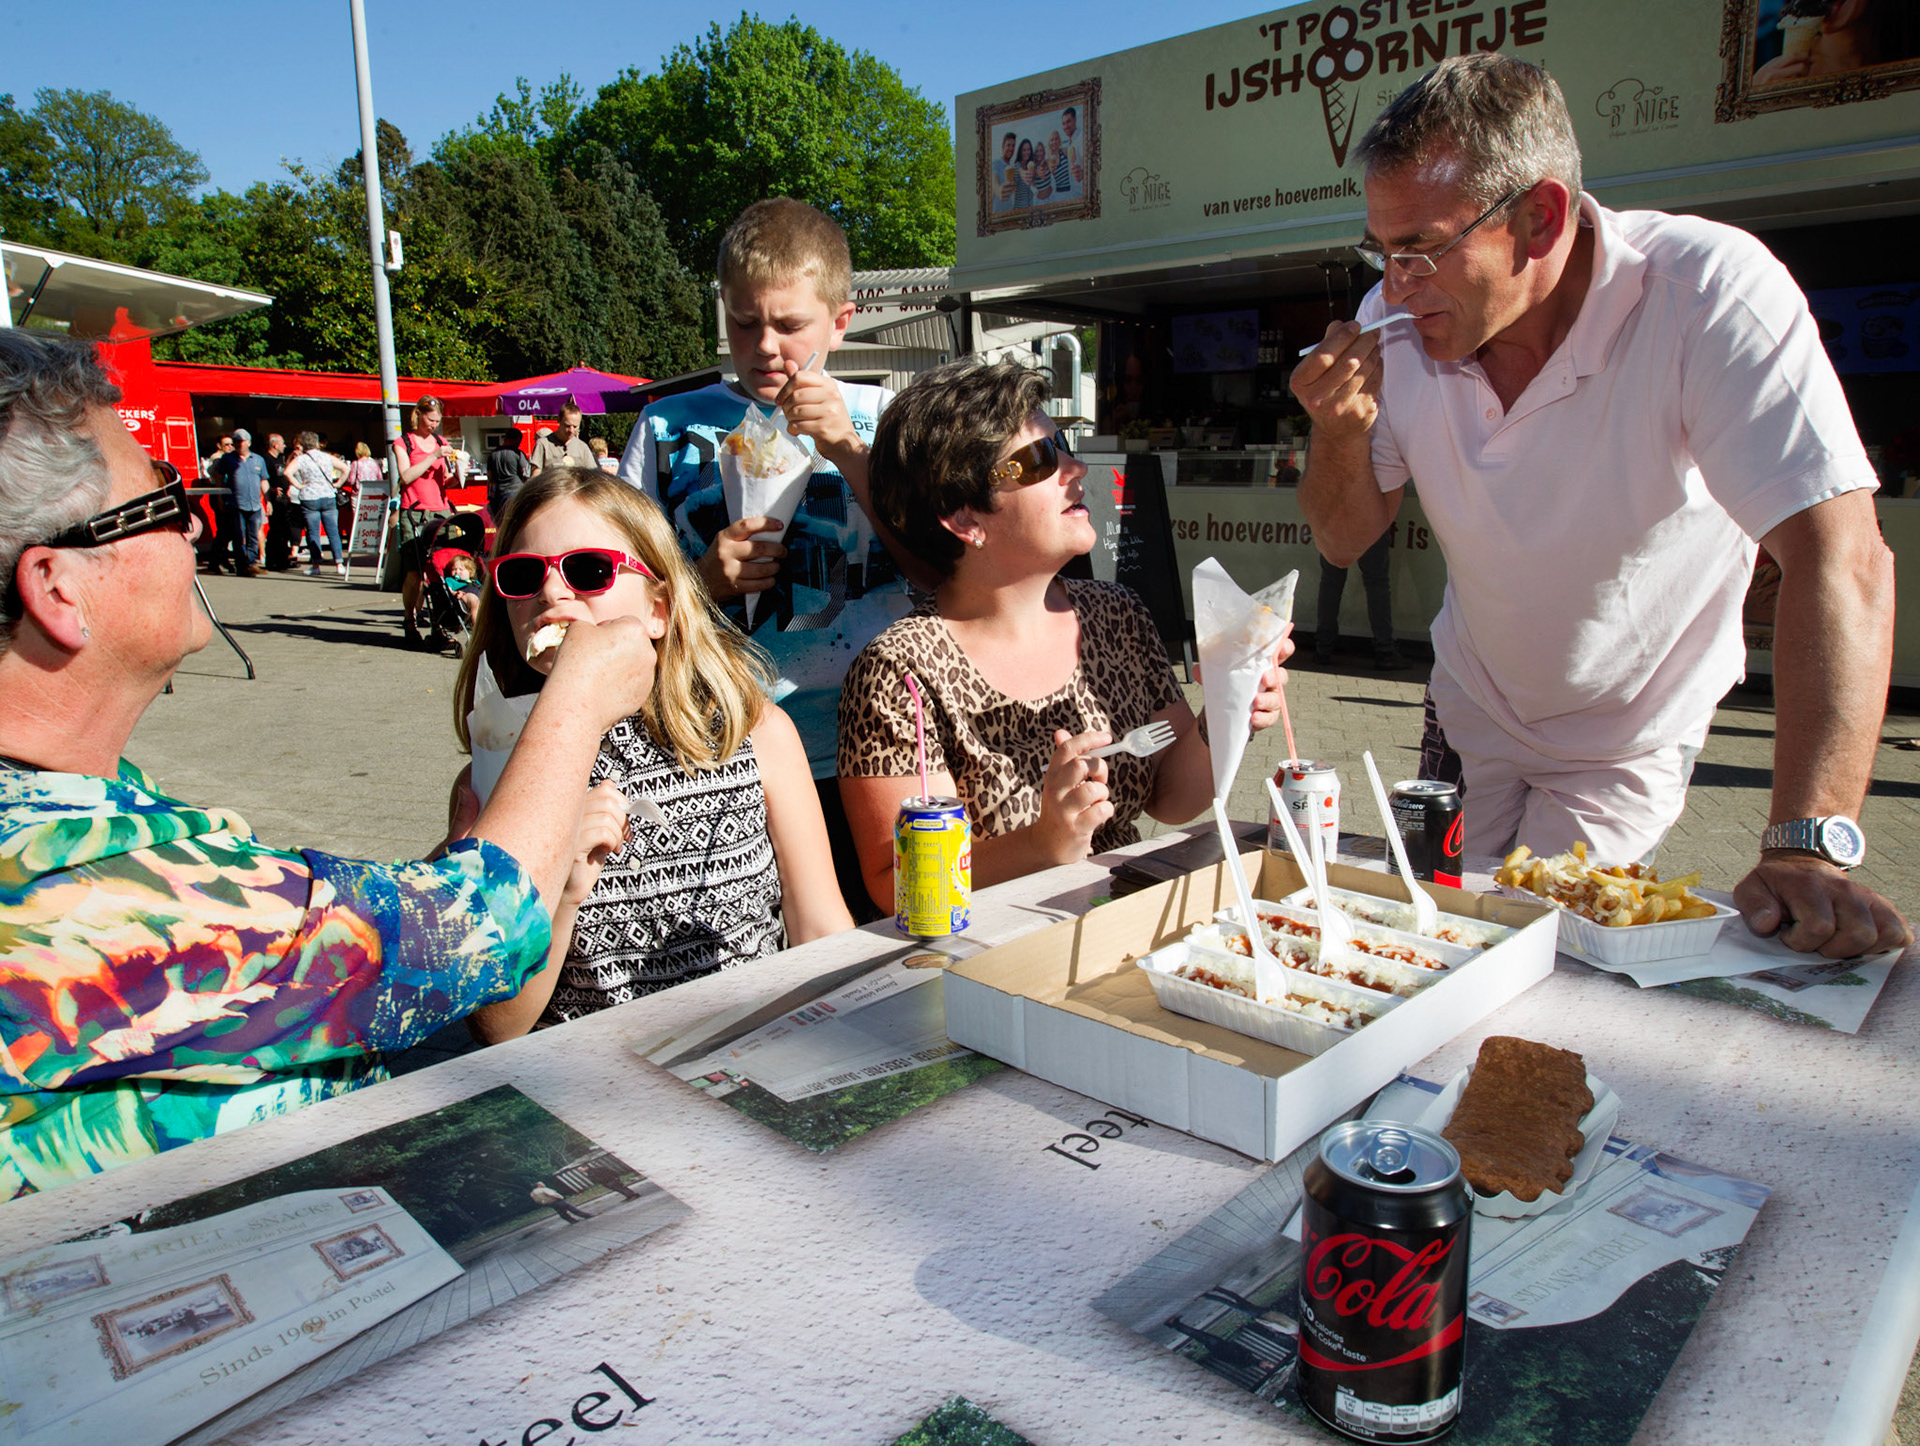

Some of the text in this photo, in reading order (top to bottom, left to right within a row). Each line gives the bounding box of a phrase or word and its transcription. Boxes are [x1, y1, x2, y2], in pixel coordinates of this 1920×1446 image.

[1297, 0, 1476, 49] POSTE
[1206, 0, 1548, 111] IJSHOORNTJE
[1203, 177, 1362, 217] van verse hoevemelk,
[518, 399, 541, 411] OLA
[1206, 512, 1312, 546] hoeveme
[131, 1226, 226, 1262] FRIET
[247, 1201, 335, 1231] SNACKS
[198, 1341, 274, 1387] Sinds
[328, 1305, 347, 1322] in
[348, 1280, 396, 1311] Postel
[1315, 1320, 1345, 1343] calories
[1342, 1348, 1367, 1363] taste
